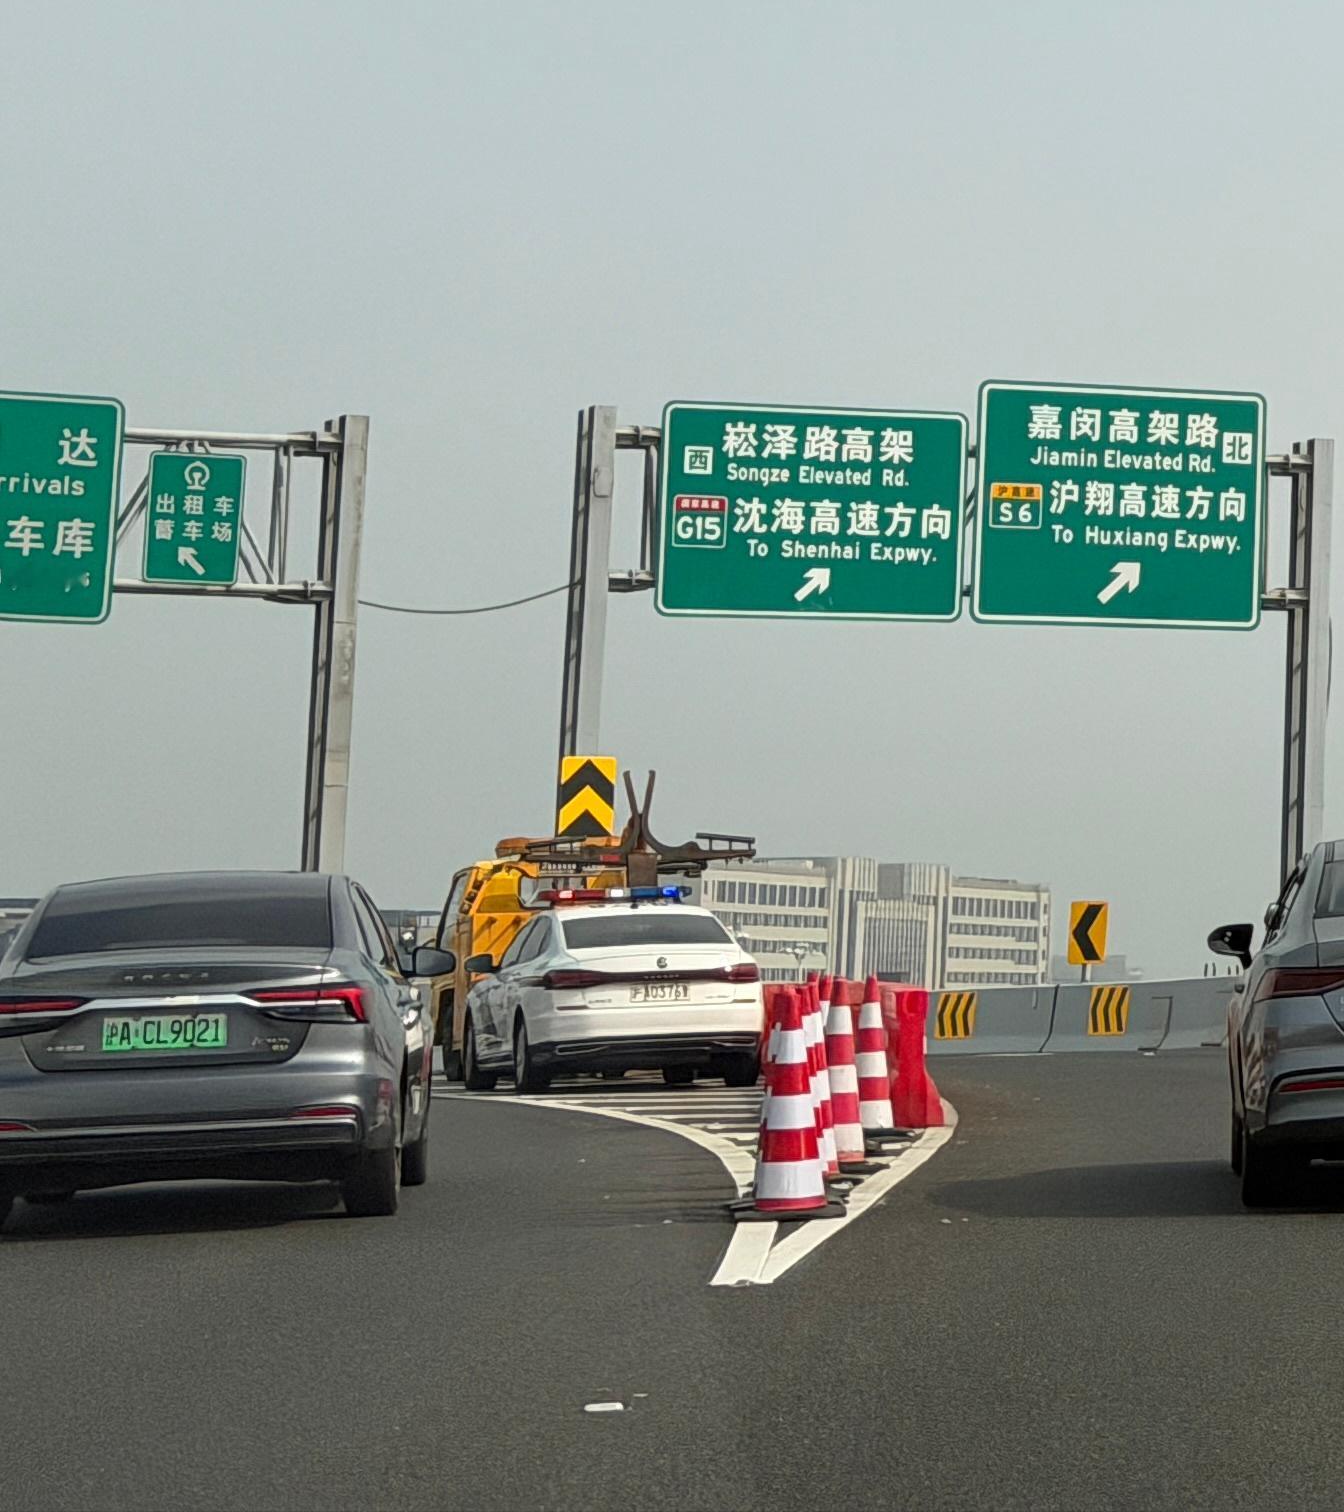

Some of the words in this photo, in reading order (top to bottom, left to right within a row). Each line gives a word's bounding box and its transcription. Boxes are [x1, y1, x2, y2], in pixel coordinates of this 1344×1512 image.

[1027, 403, 1220, 448] 嘉闵高架路
[57, 428, 98, 467] 达
[721, 421, 914, 464] 崧泽路高架
[1225, 434, 1249, 461] 北
[687, 449, 710, 471] 西
[1030, 445, 1098, 468] Jiamin
[1103, 449, 1183, 472] Elevated
[1188, 453, 1217, 474] Rd.
[727, 463, 791, 487] Songze
[798, 465, 872, 486] Elevated
[882, 468, 910, 487] Rd.
[156, 493, 235, 516] 出租车
[1049, 479, 1246, 522] 沪翔高速方向
[676, 515, 721, 541] G15
[732, 497, 952, 539] 沈海高速方向
[4, 515, 95, 559] 车库
[746, 538, 769, 557] To
[781, 541, 860, 560] Shenhai
[870, 542, 937, 565] Expwy.
[1051, 524, 1074, 544] To
[1085, 525, 1168, 553] Huxiang
[1174, 529, 1241, 555] Expwy.
[143, 1018, 220, 1044] CL9021
